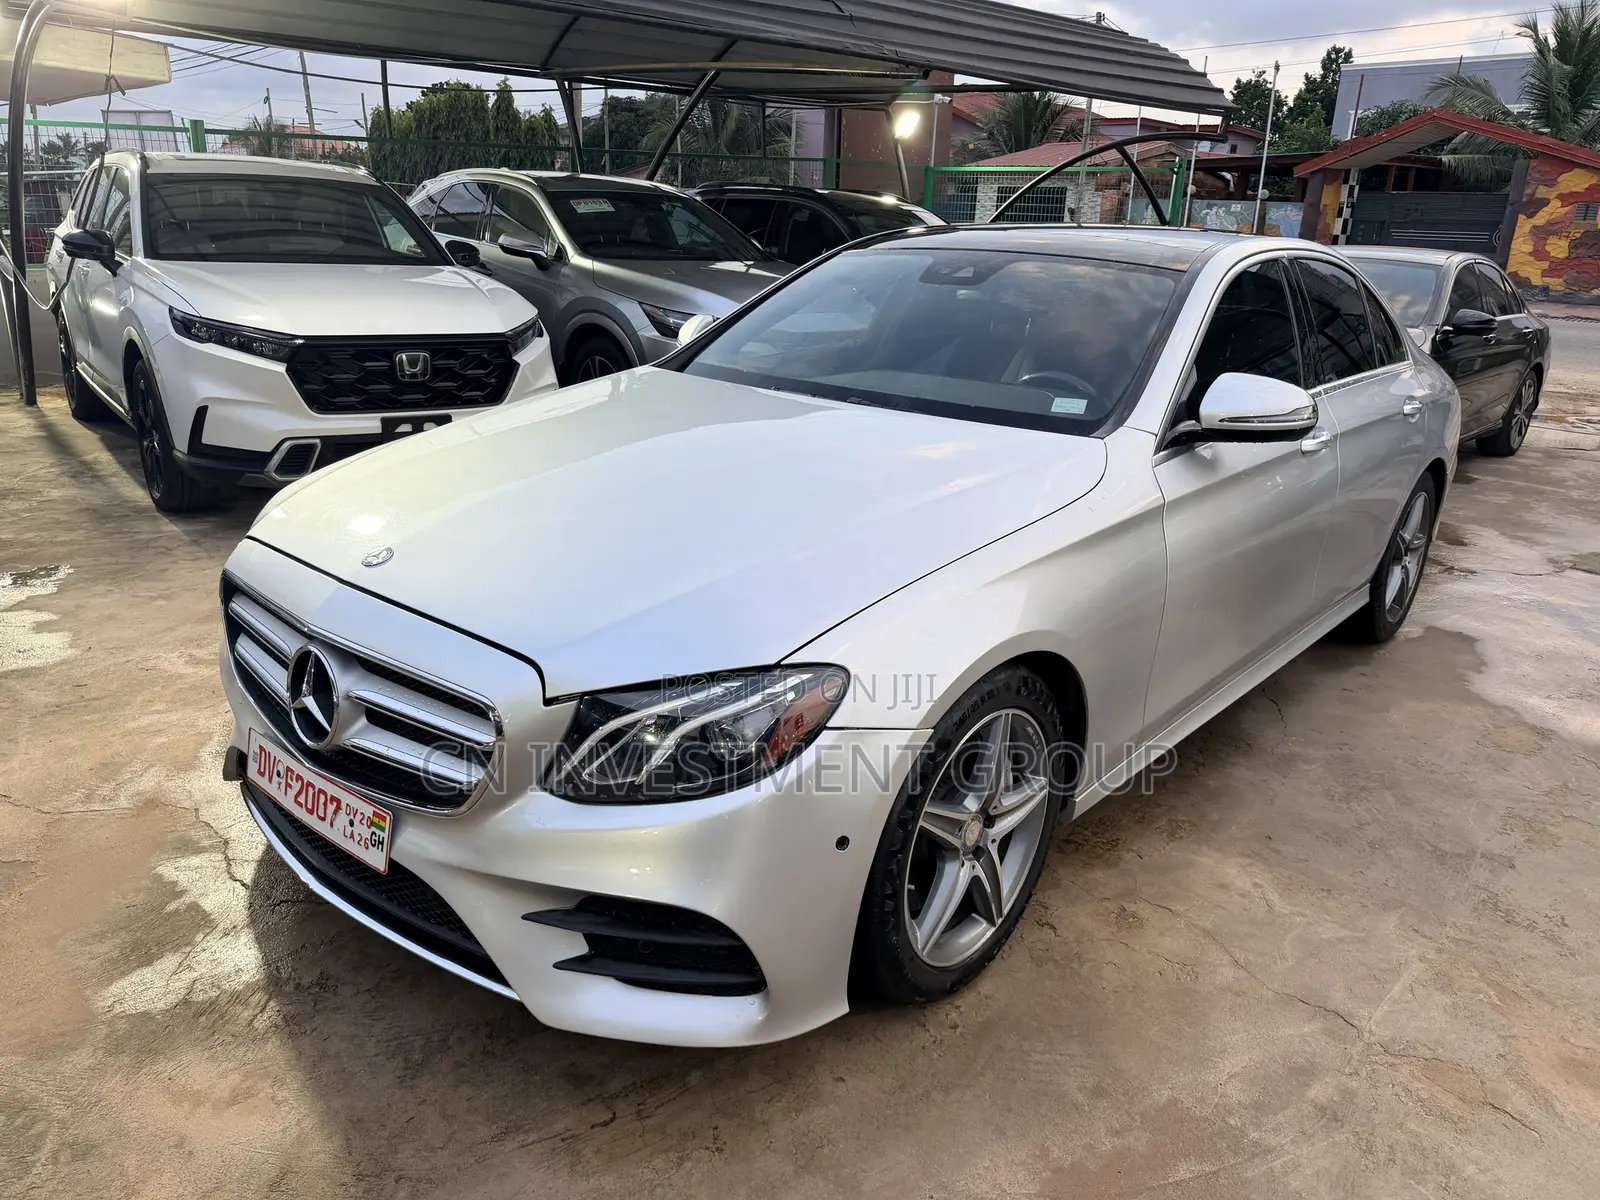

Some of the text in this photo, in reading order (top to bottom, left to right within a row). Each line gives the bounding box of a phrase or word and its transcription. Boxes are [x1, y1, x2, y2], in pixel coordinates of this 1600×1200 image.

[257, 743, 342, 829] DV F2007
[370, 831, 385, 852] GH
